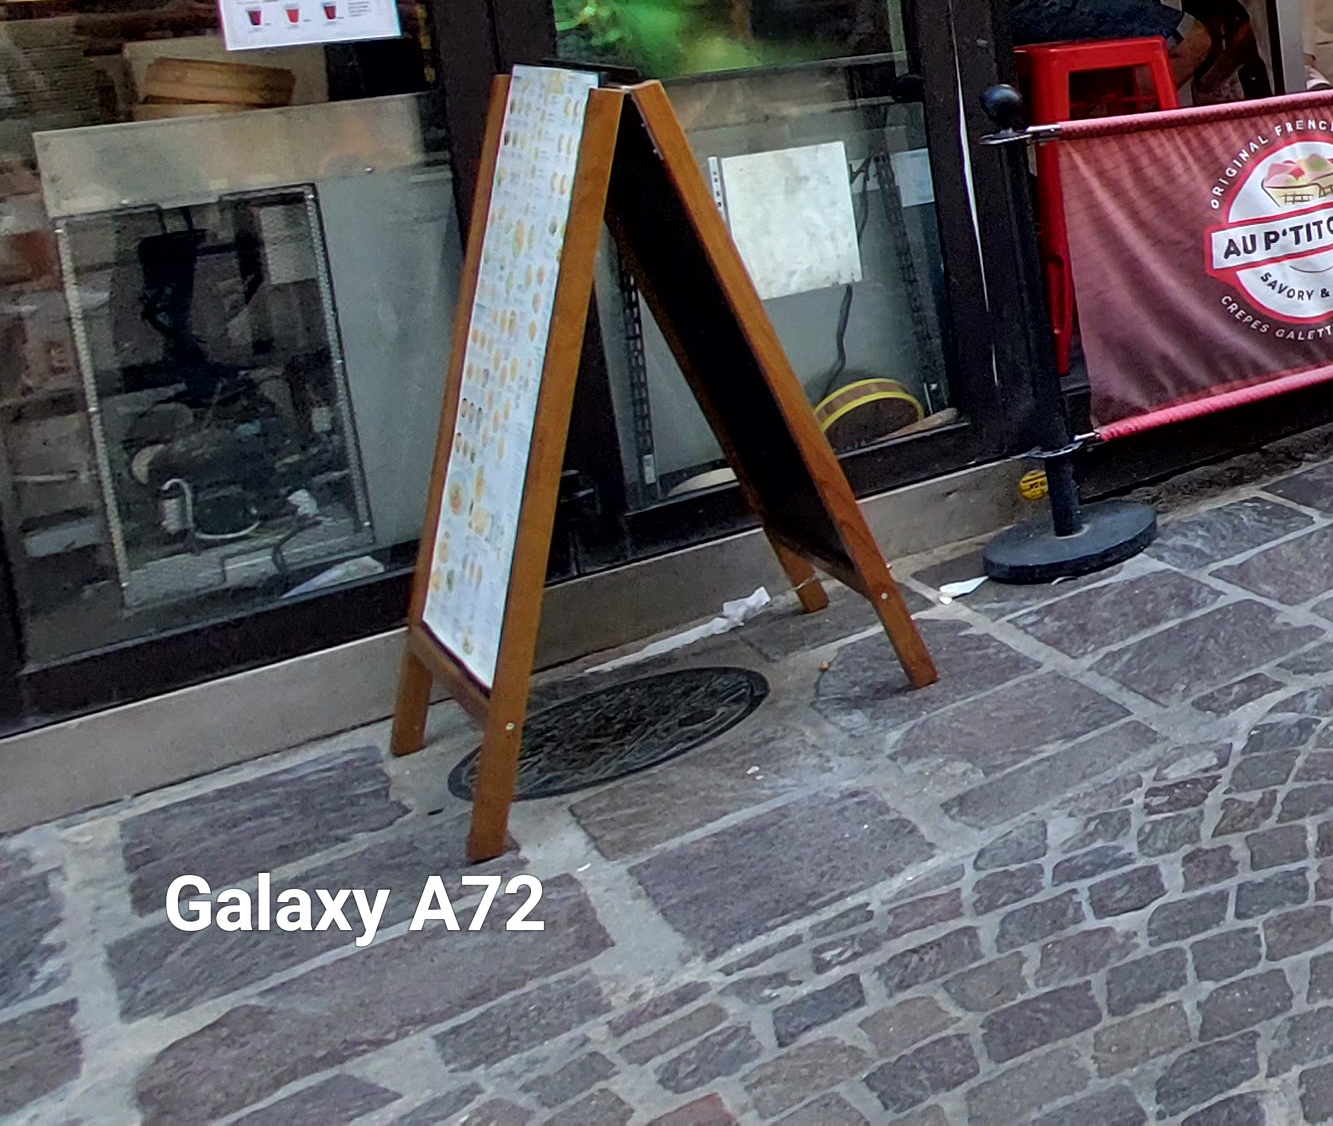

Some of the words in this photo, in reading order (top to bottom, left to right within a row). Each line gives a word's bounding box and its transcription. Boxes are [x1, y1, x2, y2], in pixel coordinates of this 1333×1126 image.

[1210, 135, 1269, 210] ORIGINAL
[1223, 234, 1258, 260] AU
[1263, 220, 1325, 251] P'TIT
[1260, 272, 1315, 301] SAVORY
[1320, 288, 1330, 298] &
[1220, 295, 1270, 333] CREPES
